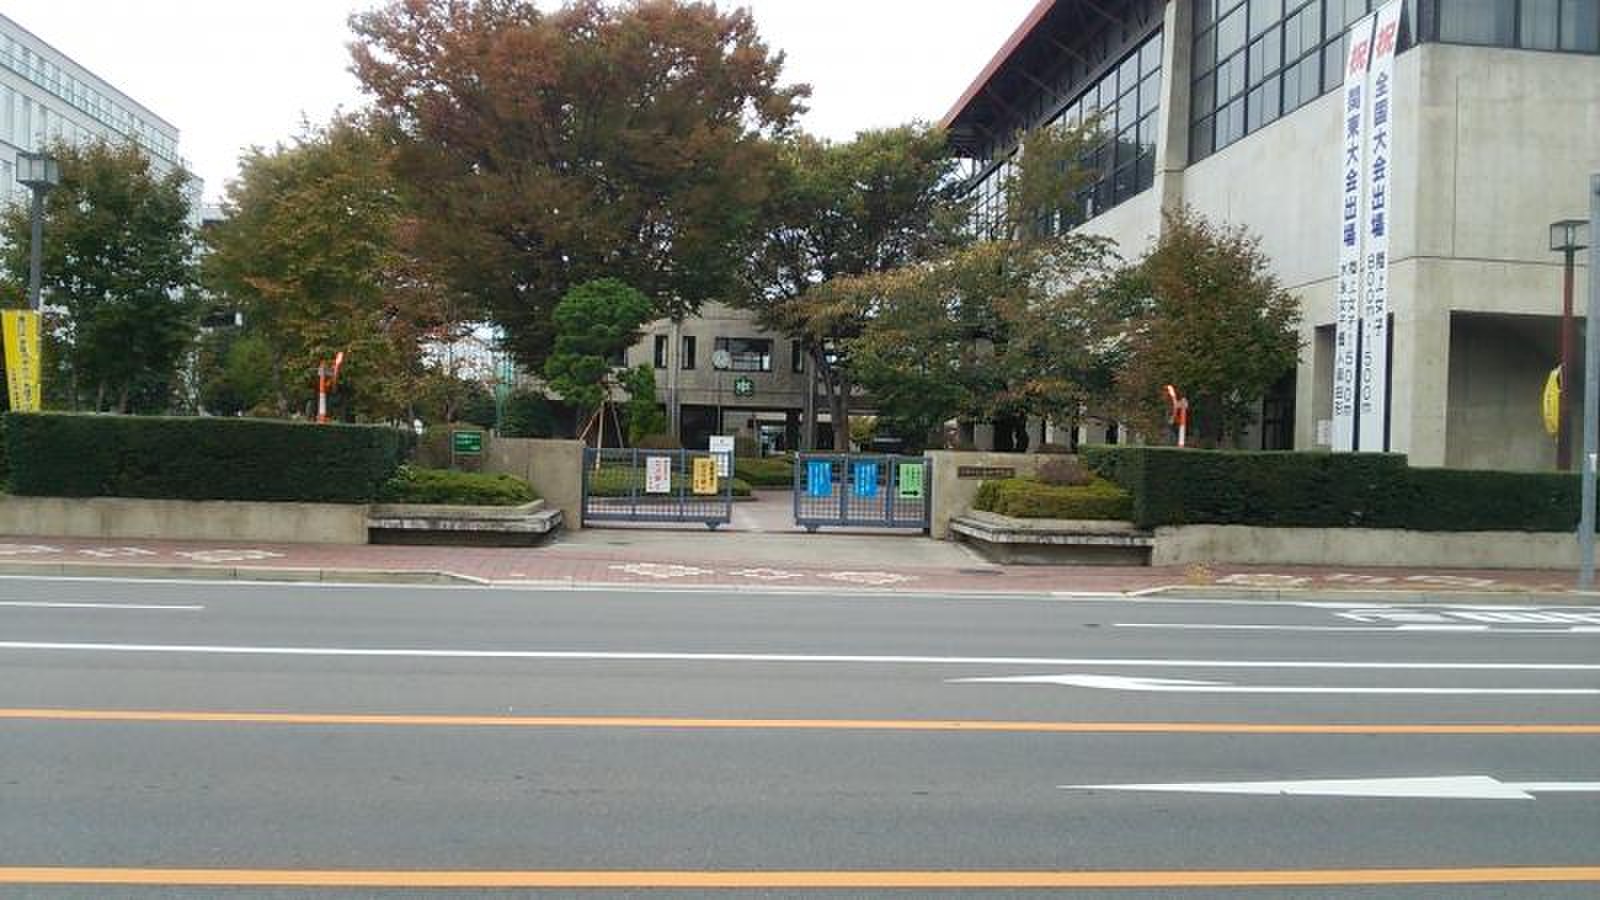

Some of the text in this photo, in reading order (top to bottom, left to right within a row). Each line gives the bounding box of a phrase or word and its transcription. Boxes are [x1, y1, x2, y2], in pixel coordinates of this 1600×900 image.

[1344, 85, 1360, 246] 関東大会出場
[1371, 72, 1388, 238] 全国大会出場
